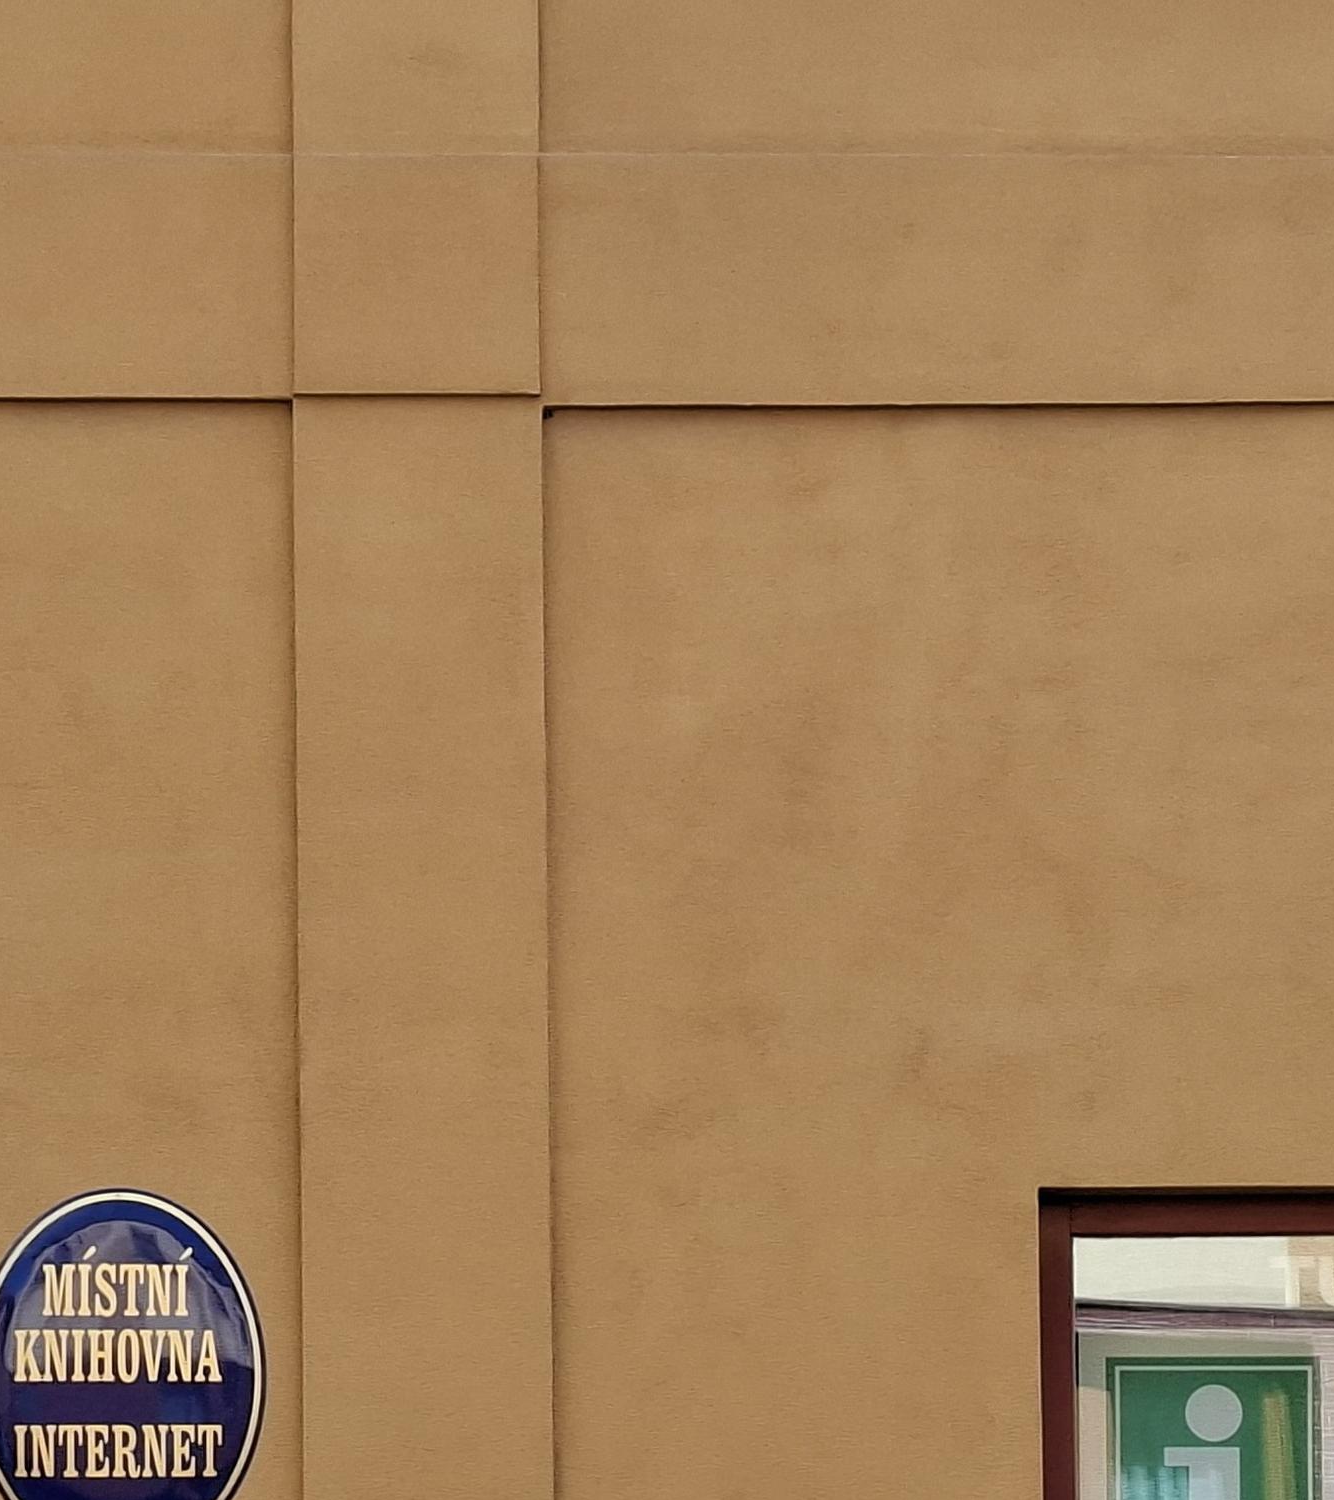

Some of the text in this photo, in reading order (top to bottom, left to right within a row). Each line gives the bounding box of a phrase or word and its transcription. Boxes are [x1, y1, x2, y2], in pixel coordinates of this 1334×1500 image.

[41, 1245, 193, 1317] MÍSTNÍ
[13, 1328, 223, 1384] KNIHOVNA
[13, 1423, 223, 1479] INTERNET
